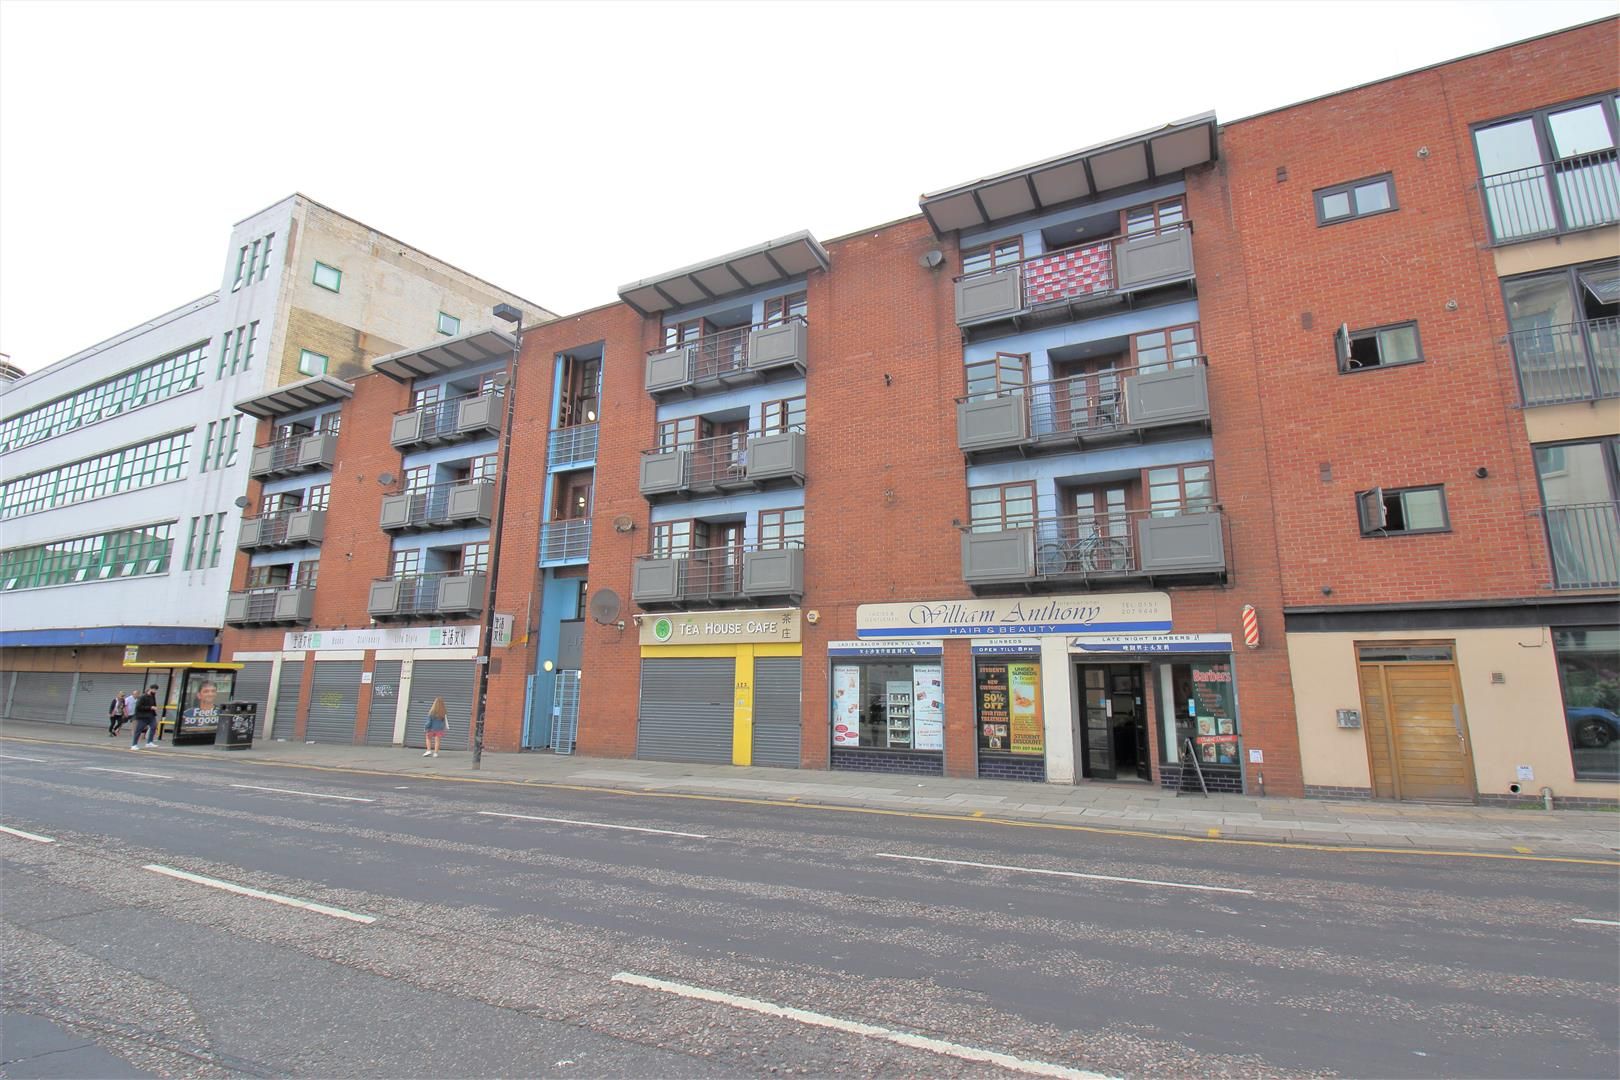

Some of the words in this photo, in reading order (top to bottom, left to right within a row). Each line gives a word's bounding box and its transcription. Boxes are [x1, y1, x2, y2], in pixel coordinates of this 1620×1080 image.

[908, 604, 996, 625] William
[1000, 600, 1101, 627] Anthony
[782, 613, 792, 624] 茶
[679, 624, 700, 635] TEA
[705, 622, 743, 635] HOUSE
[746, 620, 778, 634] CAFE
[999, 625, 1056, 633] BEAUTY
[1193, 669, 1231, 682] Barbers
[984, 694, 1005, 702] 50%
[193, 708, 217, 716] Feels
[184, 717, 197, 725] so
